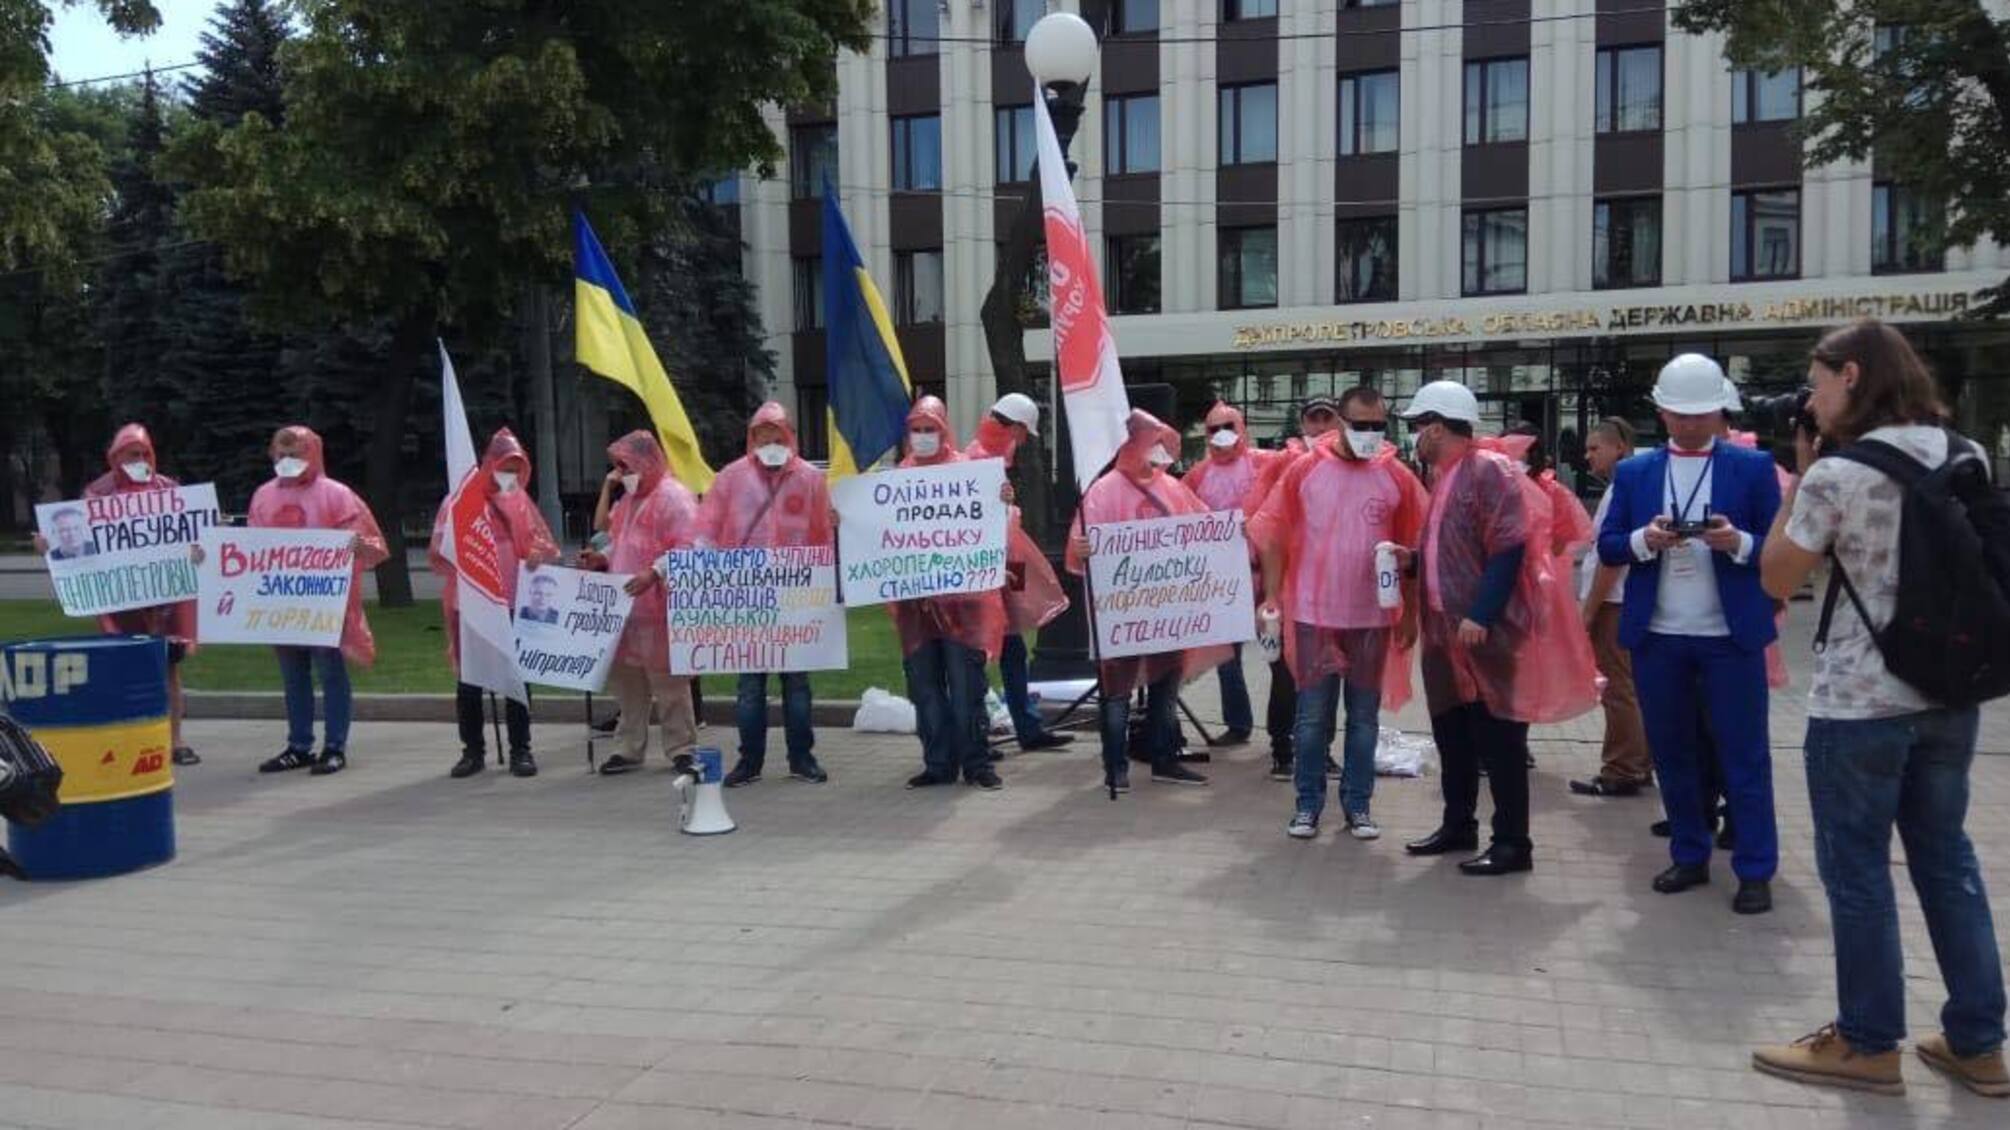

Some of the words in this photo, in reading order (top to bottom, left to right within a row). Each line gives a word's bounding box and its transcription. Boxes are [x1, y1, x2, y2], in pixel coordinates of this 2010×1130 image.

[1483, 309, 1600, 335] ОБЛАСНА
[1608, 301, 1755, 331] ДЕРЖАВНА
[1763, 291, 1968, 321] АДМІНІСТРАЦІЯ
[87, 489, 185, 526] ДОСИТЬ
[896, 500, 984, 523] ПРОДАВ
[881, 528, 982, 550] АУЛЬСЬКУ
[668, 586, 779, 612] ПОСАДОВЦІВ
